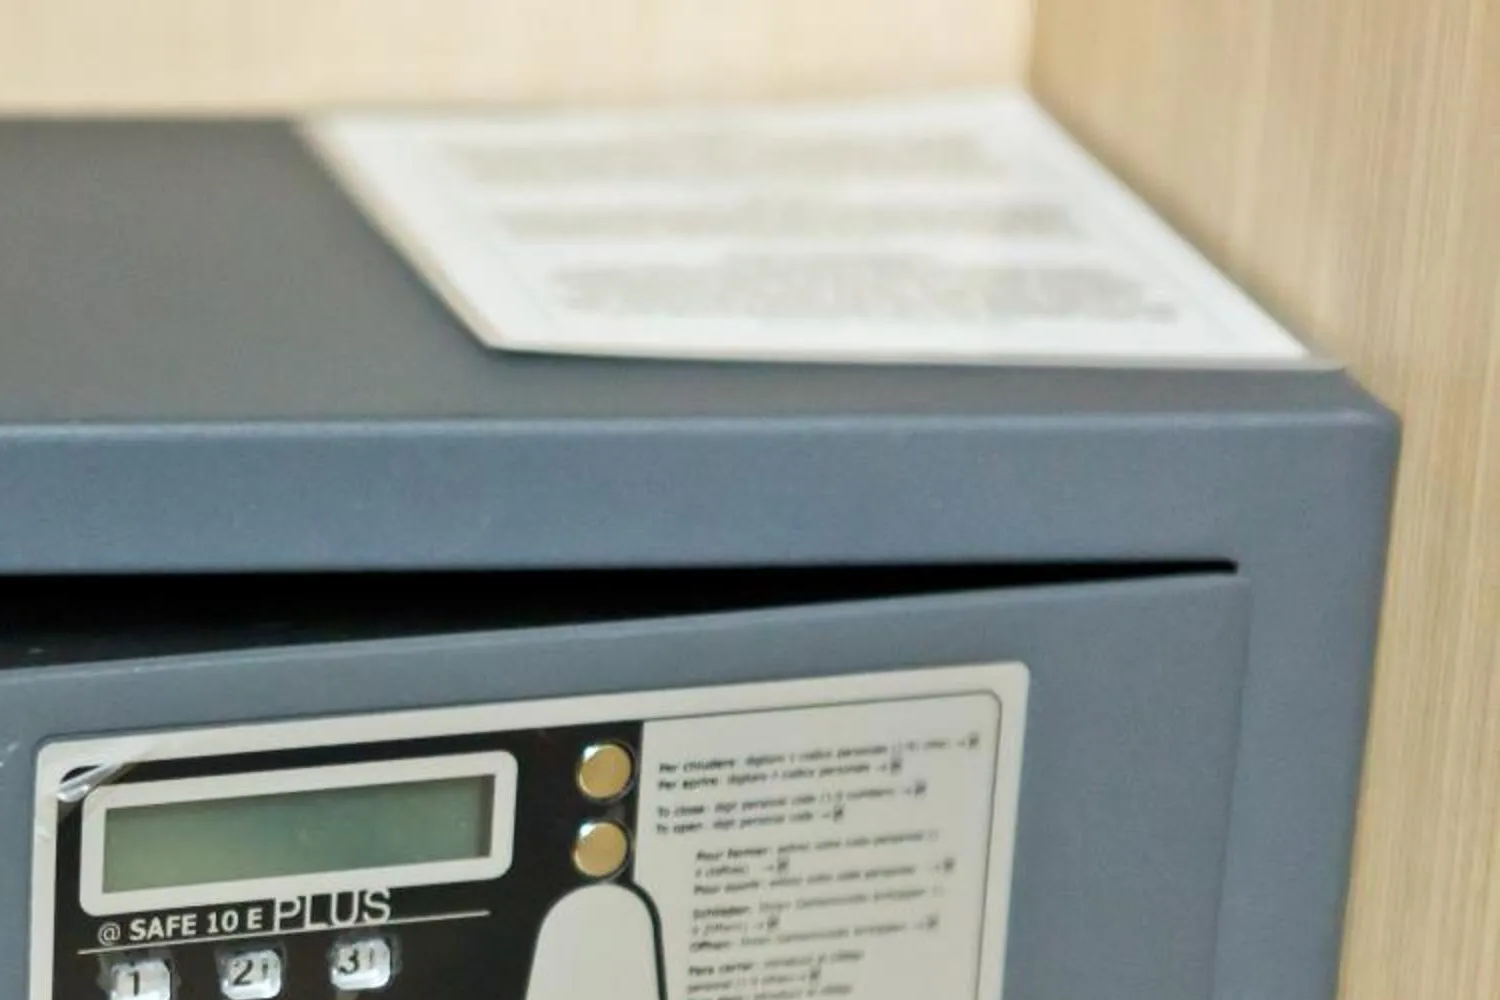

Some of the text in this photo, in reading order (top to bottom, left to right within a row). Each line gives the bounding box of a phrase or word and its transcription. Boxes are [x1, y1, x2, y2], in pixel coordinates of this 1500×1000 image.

[129, 913, 197, 941] SAFE
[207, 909, 239, 934] 10
[247, 907, 264, 931] E
[272, 888, 391, 933] PLUS
[129, 949, 359, 997] 1 2 3
